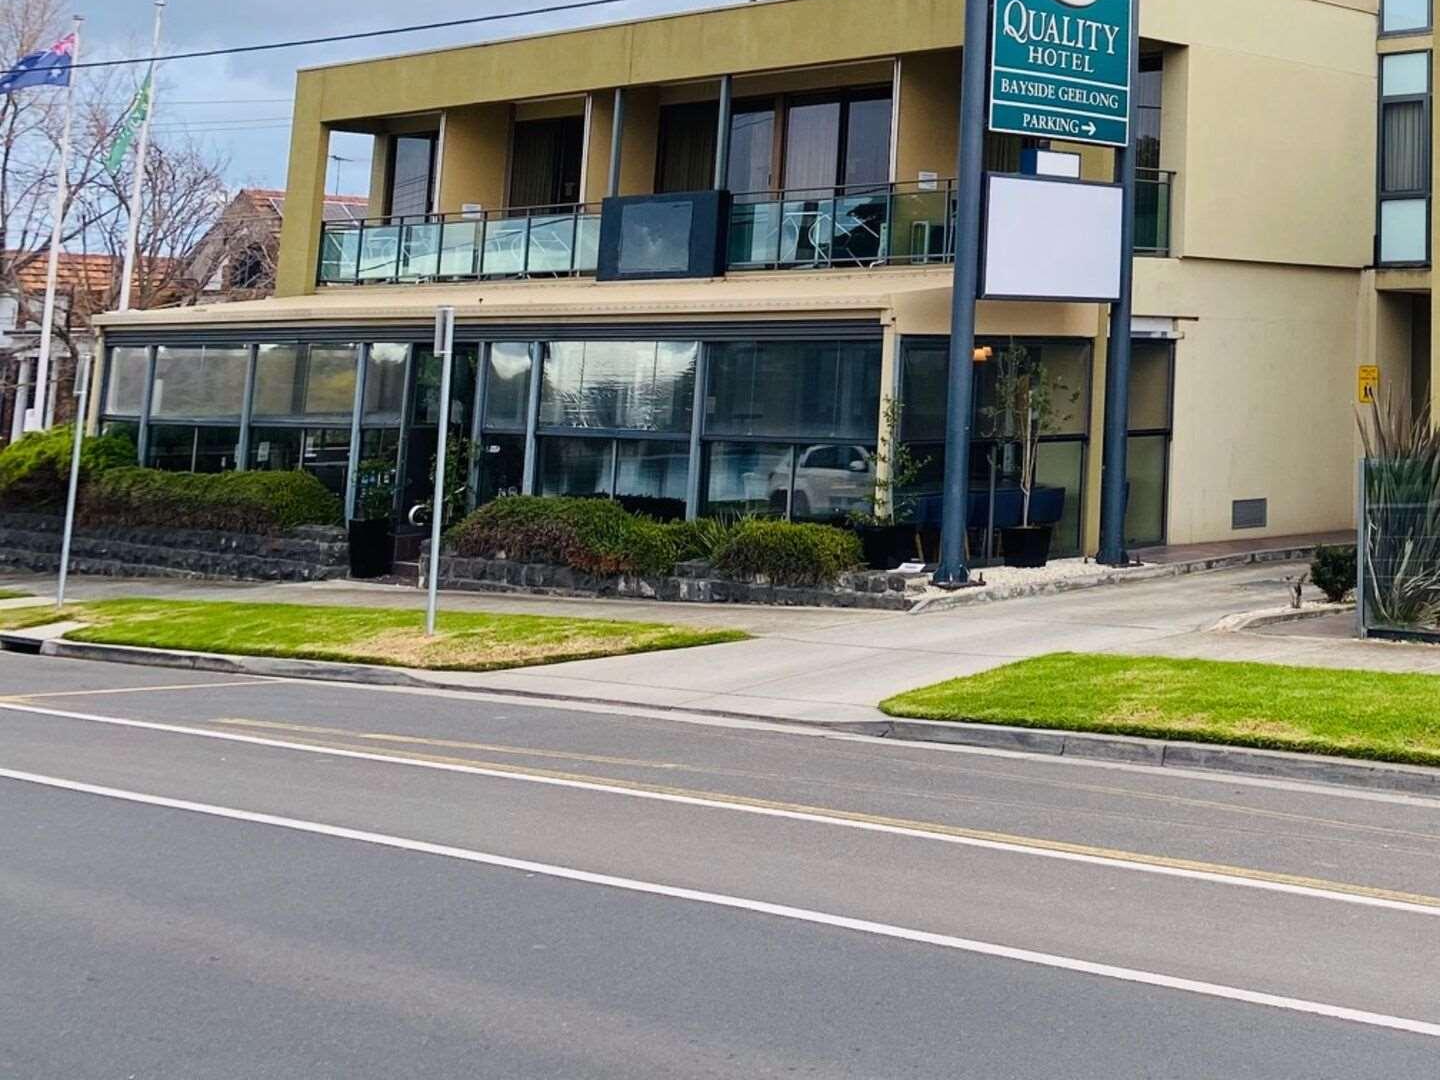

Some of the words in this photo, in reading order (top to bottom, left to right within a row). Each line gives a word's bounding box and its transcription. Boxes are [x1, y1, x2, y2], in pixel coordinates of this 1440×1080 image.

[1003, 0, 1120, 55] QUALITY
[1028, 45, 1094, 73] HOTEL
[1001, 78, 1056, 100] BAYSIDE
[1058, 86, 1119, 109] GEELONG
[1023, 113, 1079, 134] PARKING
